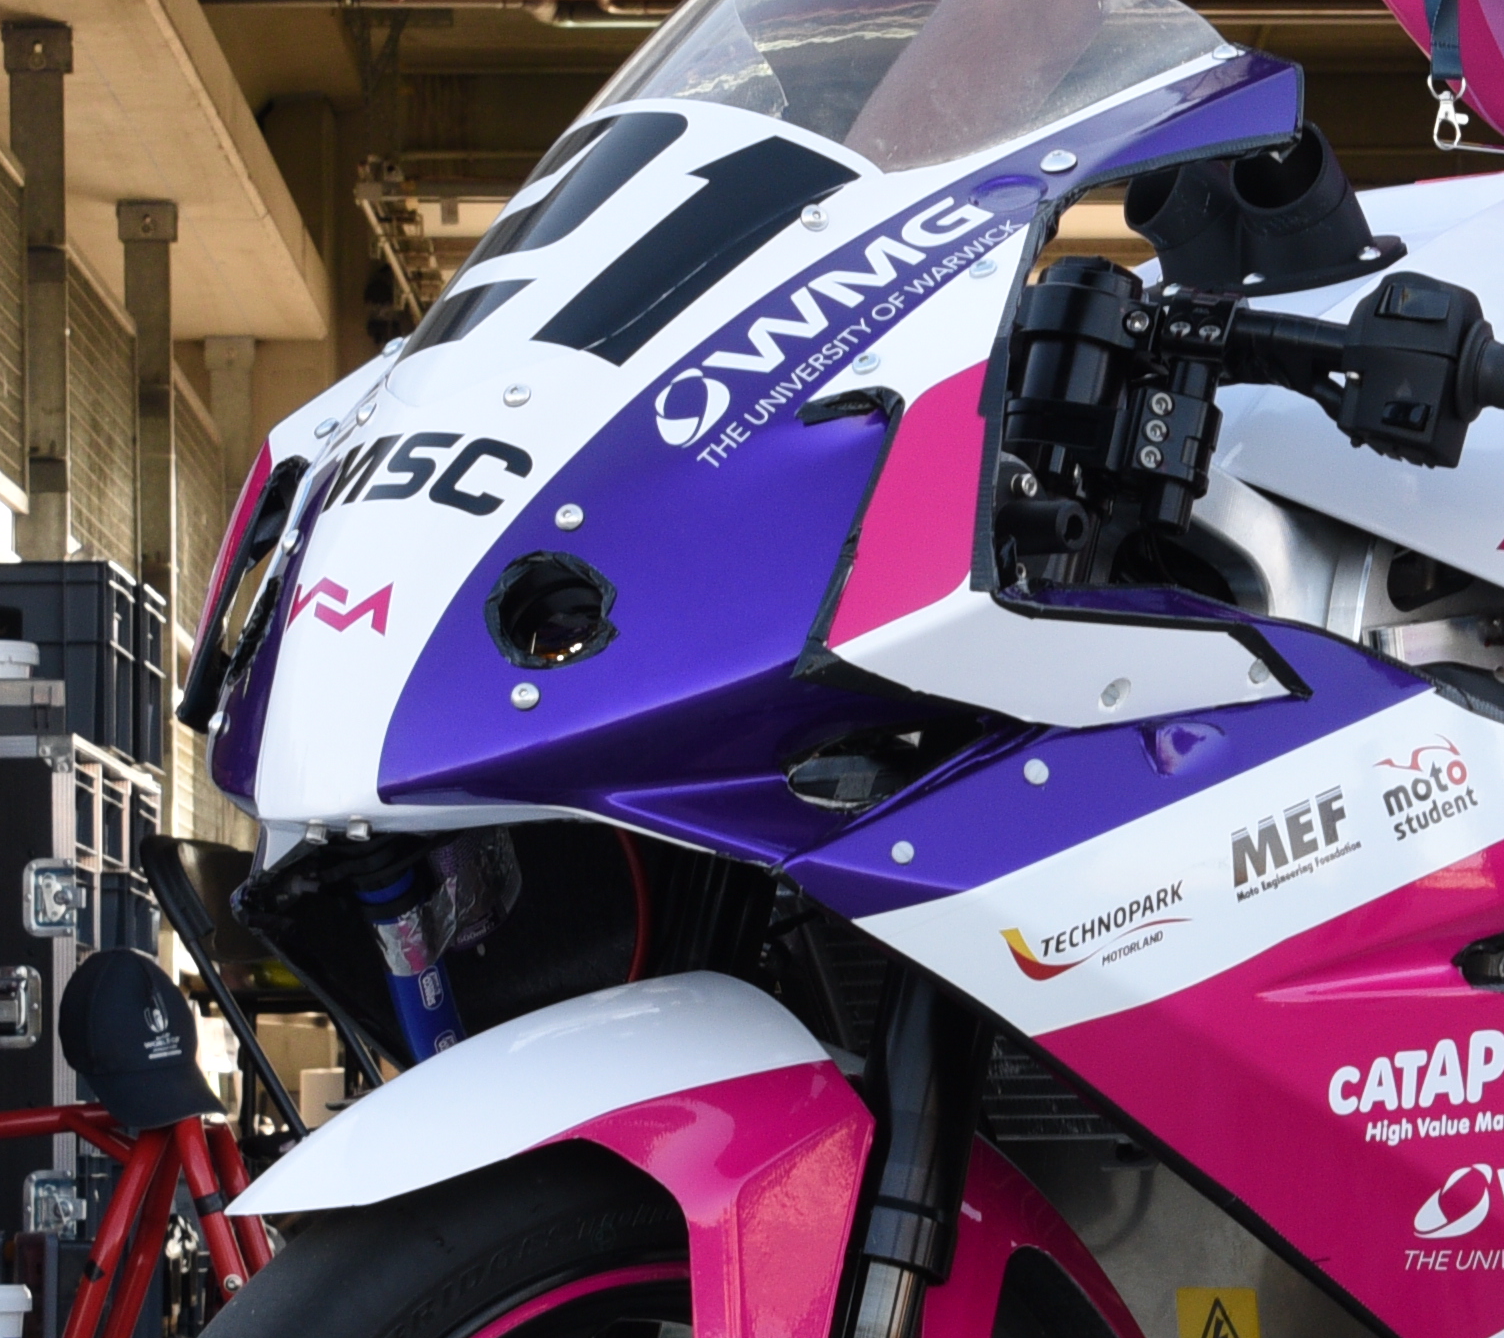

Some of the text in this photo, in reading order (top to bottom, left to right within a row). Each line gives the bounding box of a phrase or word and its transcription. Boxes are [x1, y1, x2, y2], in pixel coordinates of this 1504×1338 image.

[702, 197, 995, 372] WMG
[696, 220, 1025, 468] THE UNIVERSITY OF WARWICK
[320, 431, 533, 516] MSC
[1383, 760, 1467, 816] moto
[1394, 785, 1479, 841] student
[1231, 784, 1346, 888] MEF
[1237, 840, 1362, 902] Moto Engineering Foundation
[1041, 879, 1184, 957] TECHNOPARK
[1102, 931, 1163, 966] MOTORLAND
[1365, 1119, 1412, 1146] High
[1417, 1115, 1470, 1138] Value
[1404, 1250, 1453, 1270] THE
